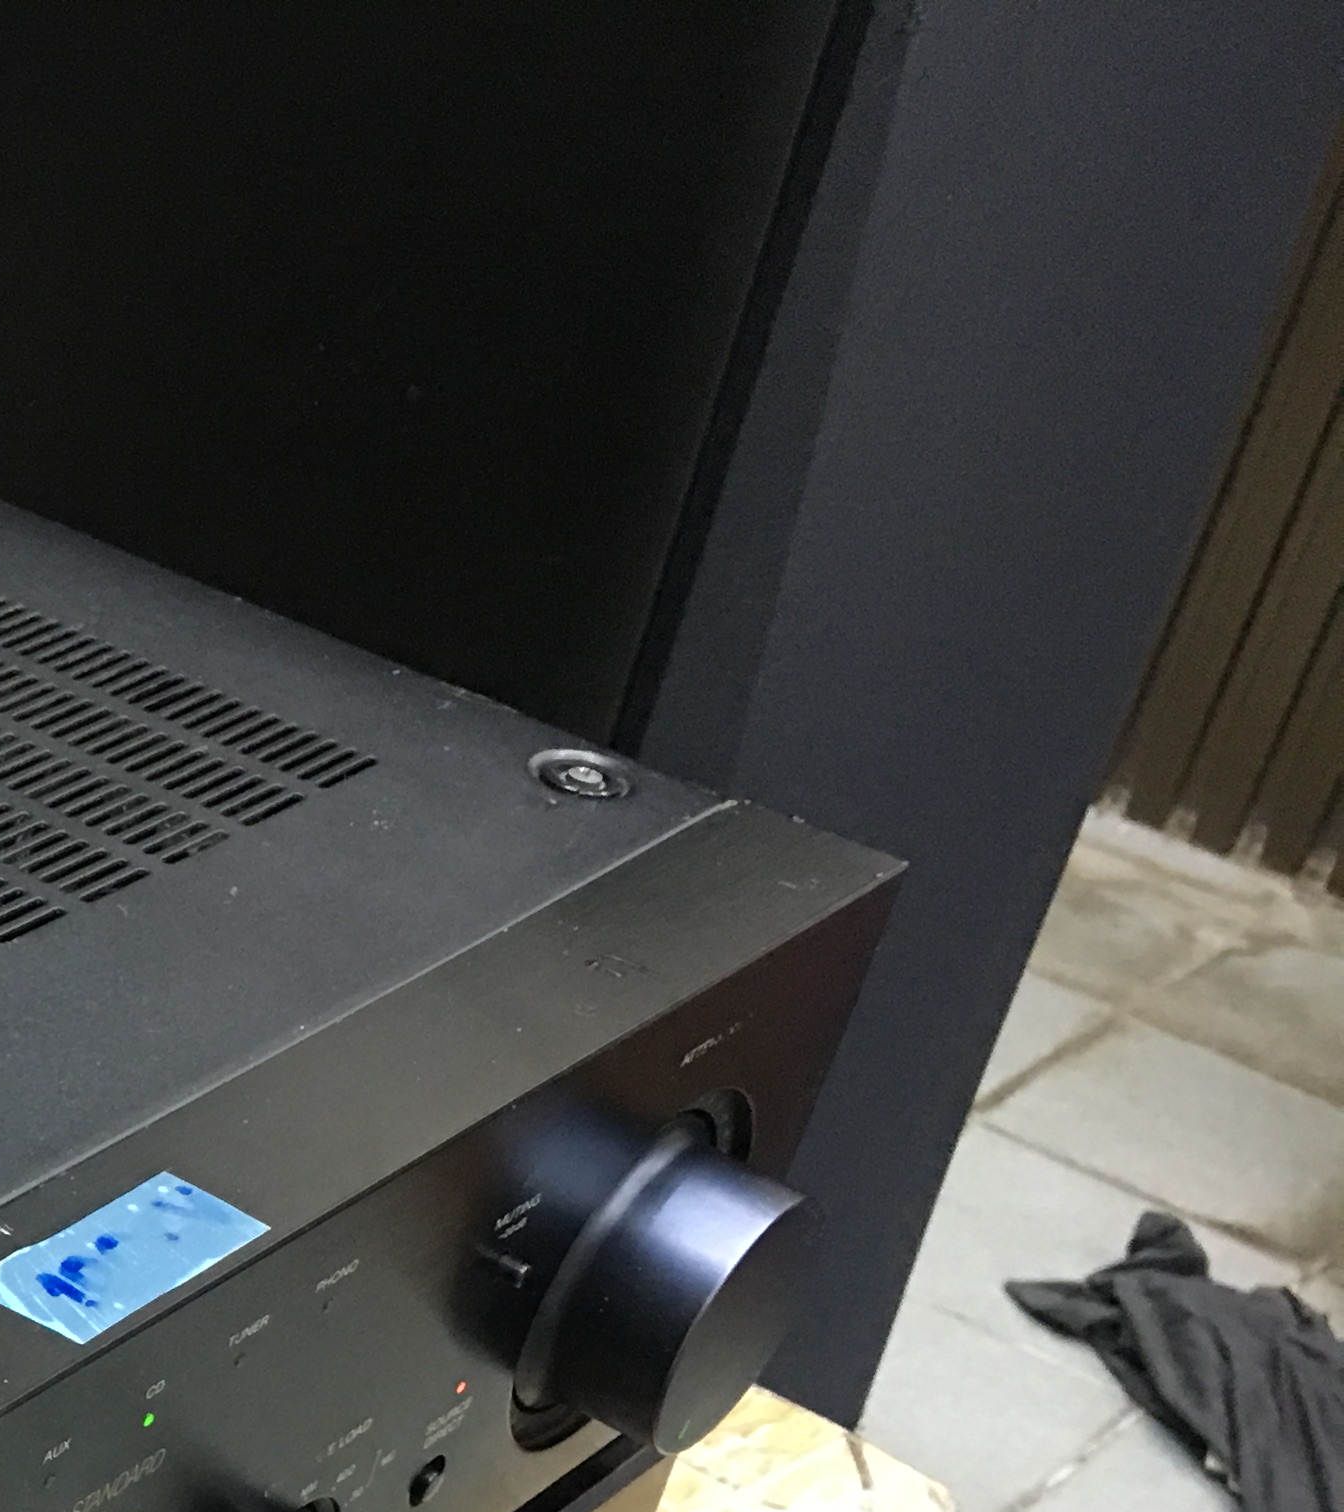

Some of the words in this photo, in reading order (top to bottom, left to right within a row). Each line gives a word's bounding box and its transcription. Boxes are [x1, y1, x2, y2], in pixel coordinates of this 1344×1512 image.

[315, 1259, 360, 1293] PHONO
[229, 1314, 270, 1347] TUNER
[146, 1380, 166, 1400] CD
[43, 1437, 72, 1465] AUX
